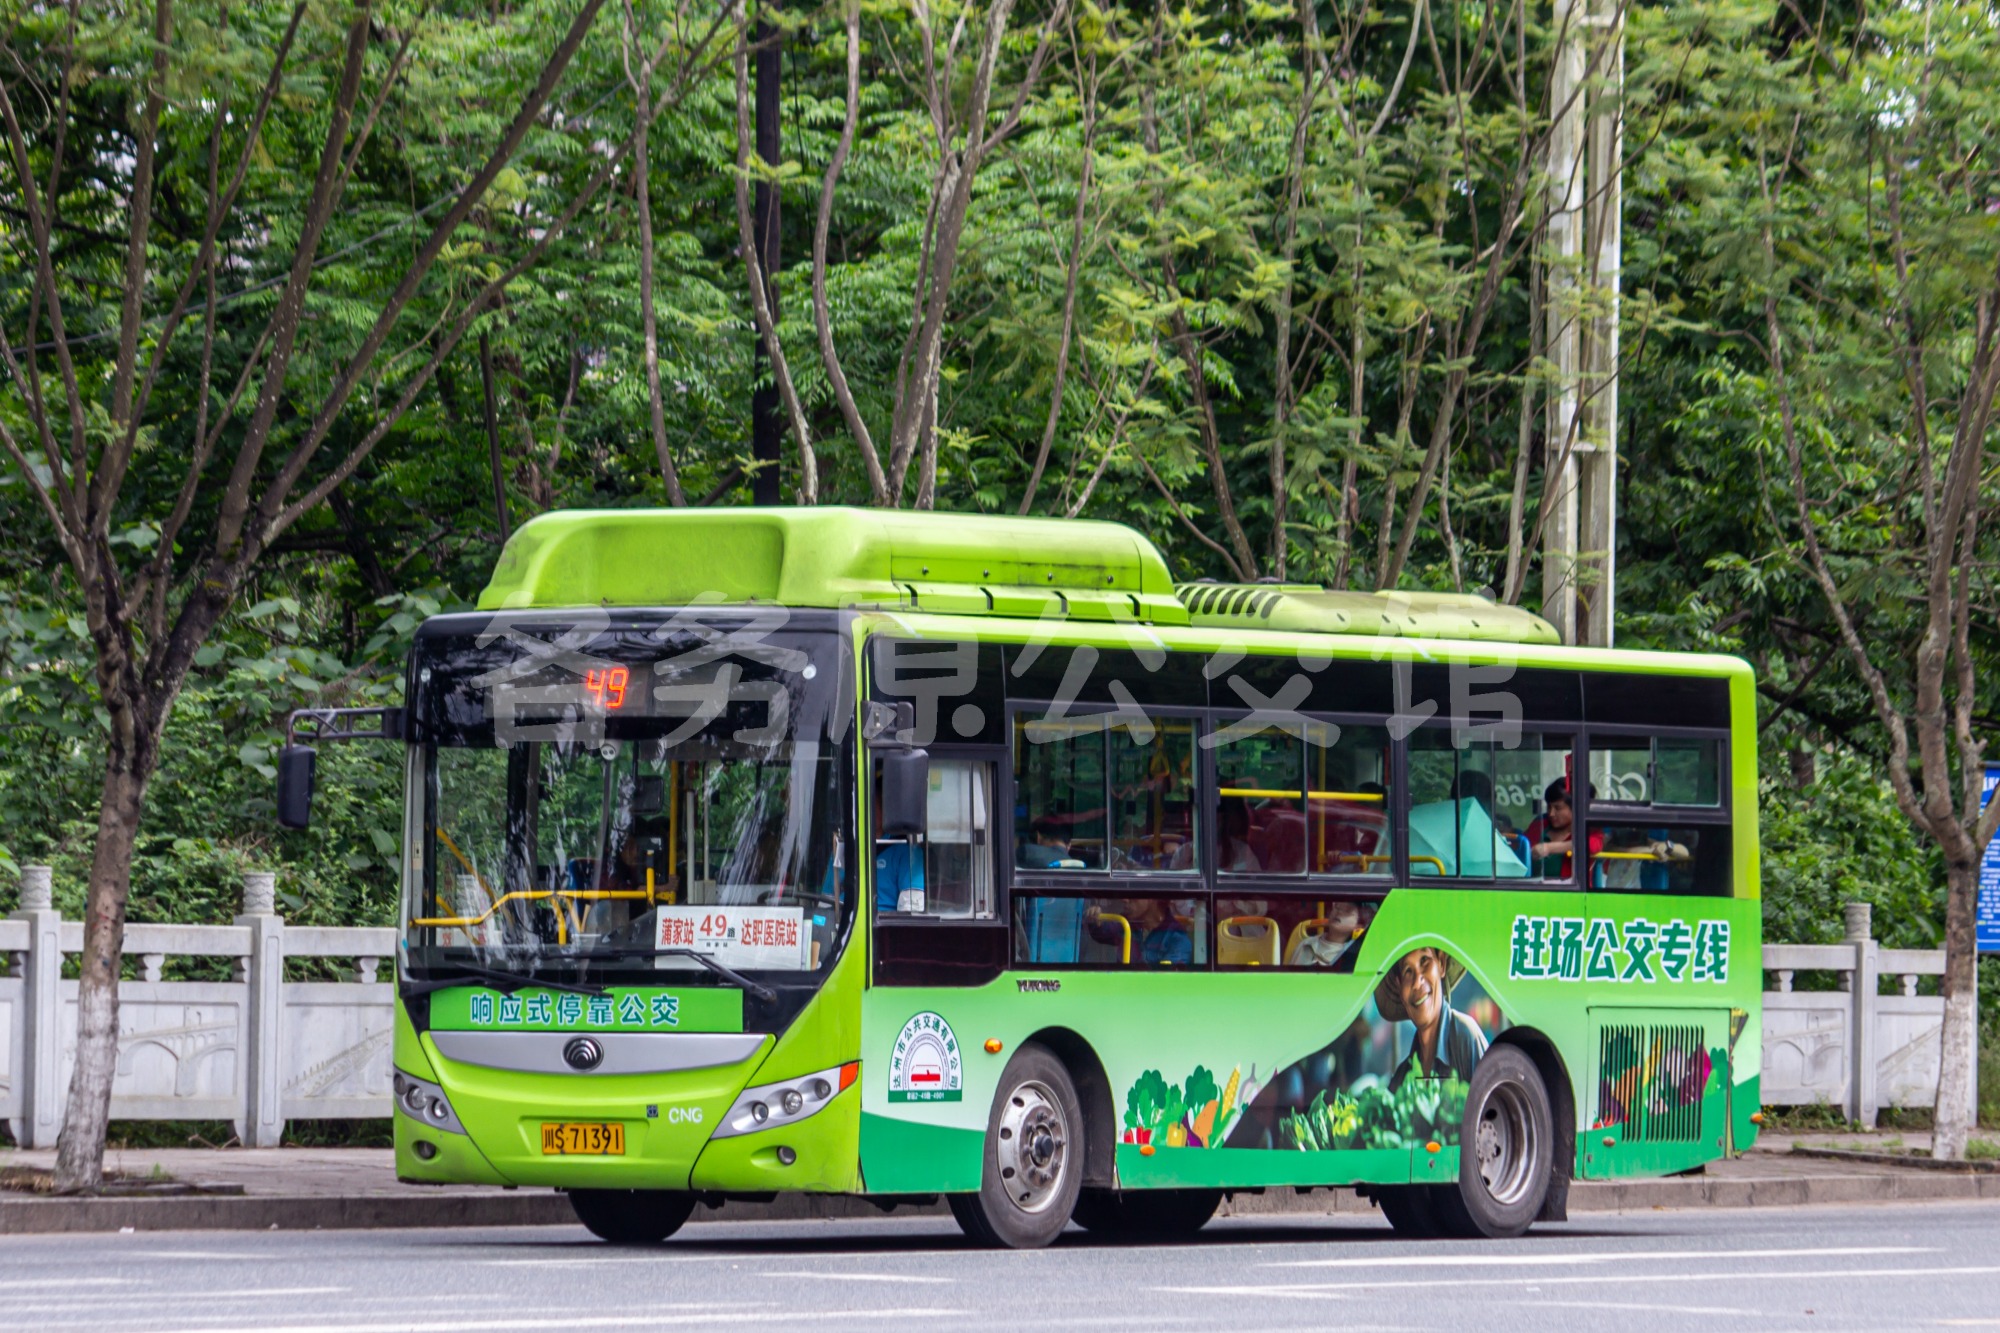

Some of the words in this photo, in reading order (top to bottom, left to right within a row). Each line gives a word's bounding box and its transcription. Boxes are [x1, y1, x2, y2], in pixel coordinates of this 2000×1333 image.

[586, 667, 629, 709] 49
[661, 917, 694, 946] 蒲家站
[741, 918, 798, 947] 达职医院站
[1509, 915, 1730, 982] 赶场公交专线
[470, 993, 679, 1026] 响应式停靠公交
[892, 1014, 959, 1089] 达州市公共交通有限公司
[668, 1107, 703, 1123] CNG
